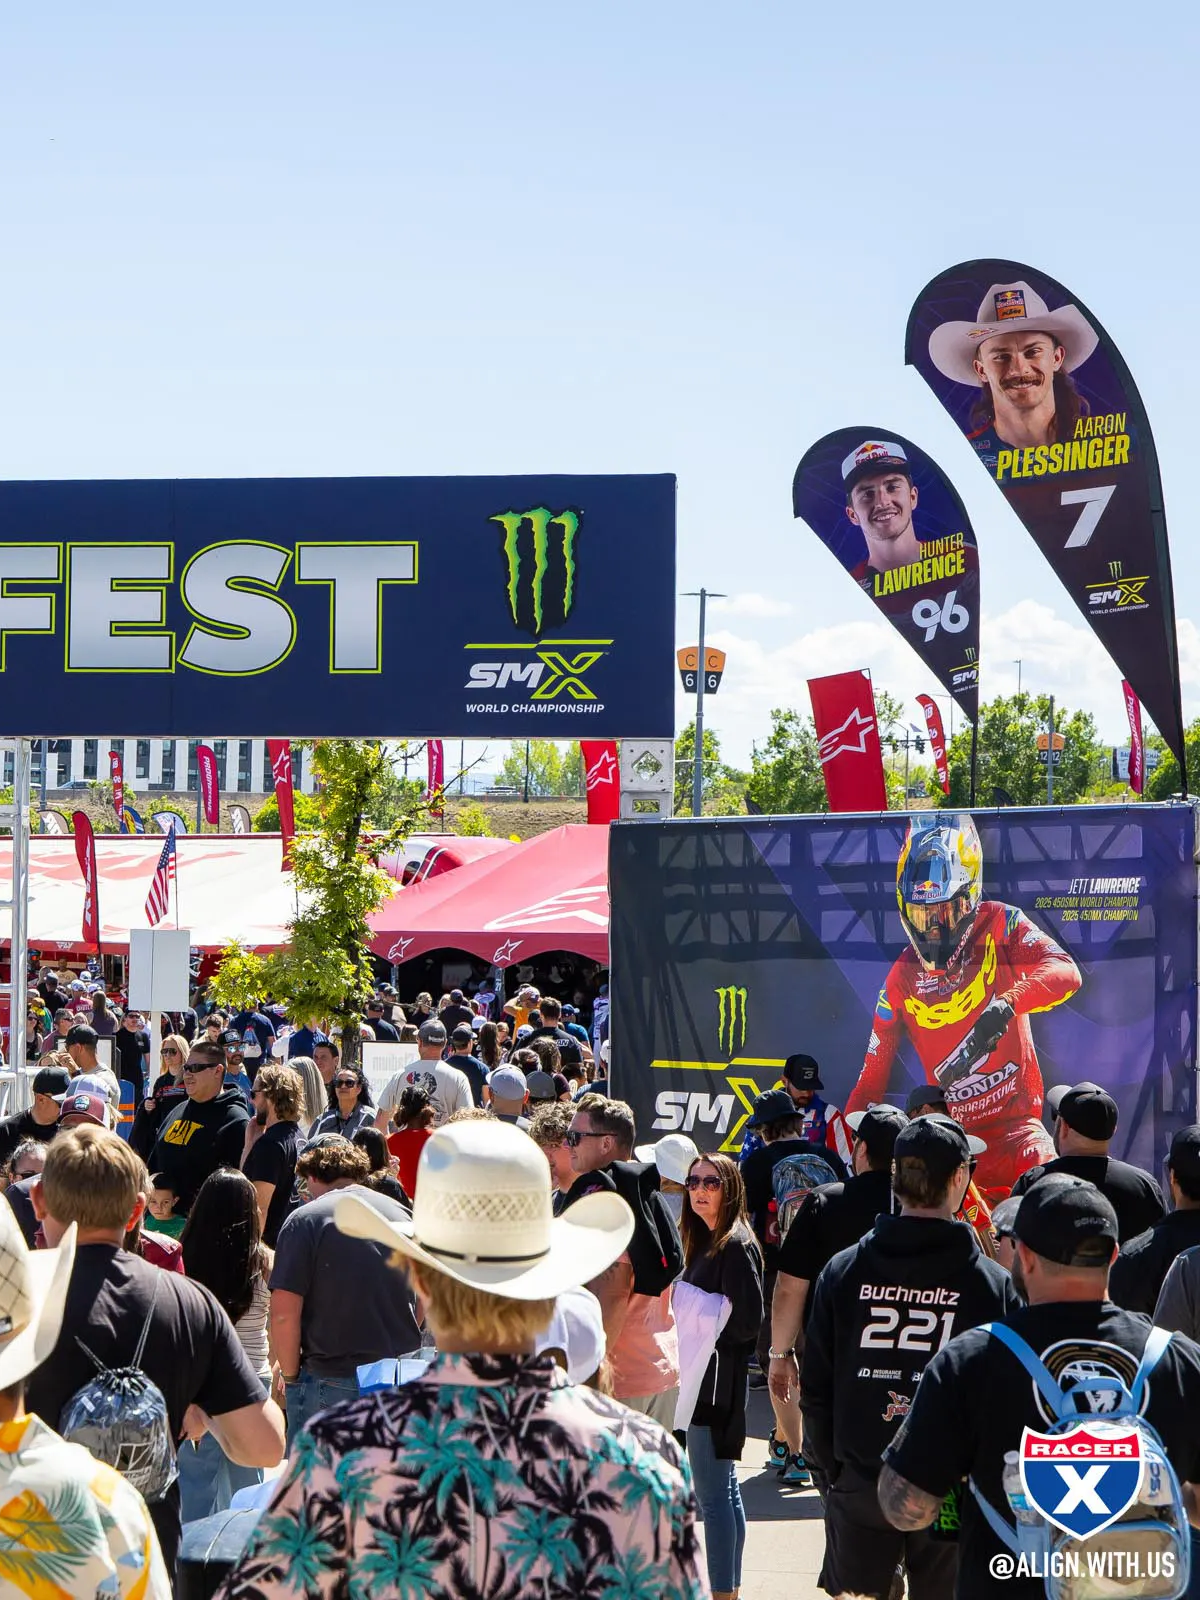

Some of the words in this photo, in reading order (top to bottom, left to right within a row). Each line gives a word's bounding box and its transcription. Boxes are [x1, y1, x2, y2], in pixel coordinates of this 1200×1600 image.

[1074, 412, 1126, 440] AARON
[997, 434, 1130, 480] PLESSINGER
[1061, 485, 1117, 548] 7
[919, 532, 964, 560] HUNTER
[874, 549, 965, 597] LAWRENCE
[1088, 582, 1146, 606] SMX
[912, 590, 969, 642] 96
[1109, 604, 1150, 613] CHAMPIONSHIP
[685, 653, 695, 667] C
[708, 655, 718, 668] C
[464, 652, 604, 699] SMX
[685, 673, 694, 687] 6
[708, 675, 717, 688] 6
[466, 704, 509, 712] WORLD
[511, 704, 605, 713] CHAMPIONSHIP
[1068, 878, 1089, 894] JETT
[1089, 877, 1140, 893] LAWRENCE
[1035, 896, 1052, 908] 2025
[1053, 896, 1079, 908] 450SMX
[1081, 896, 1102, 908] WORLD
[1103, 896, 1139, 908] CHAMPION
[1062, 910, 1079, 921] 2025
[1080, 910, 1101, 921] 450MX
[1103, 910, 1139, 921] CHAMPION
[945, 1061, 1019, 1102] HONDA
[164, 1119, 204, 1146] CAT
[860, 1306, 955, 1352] 221
